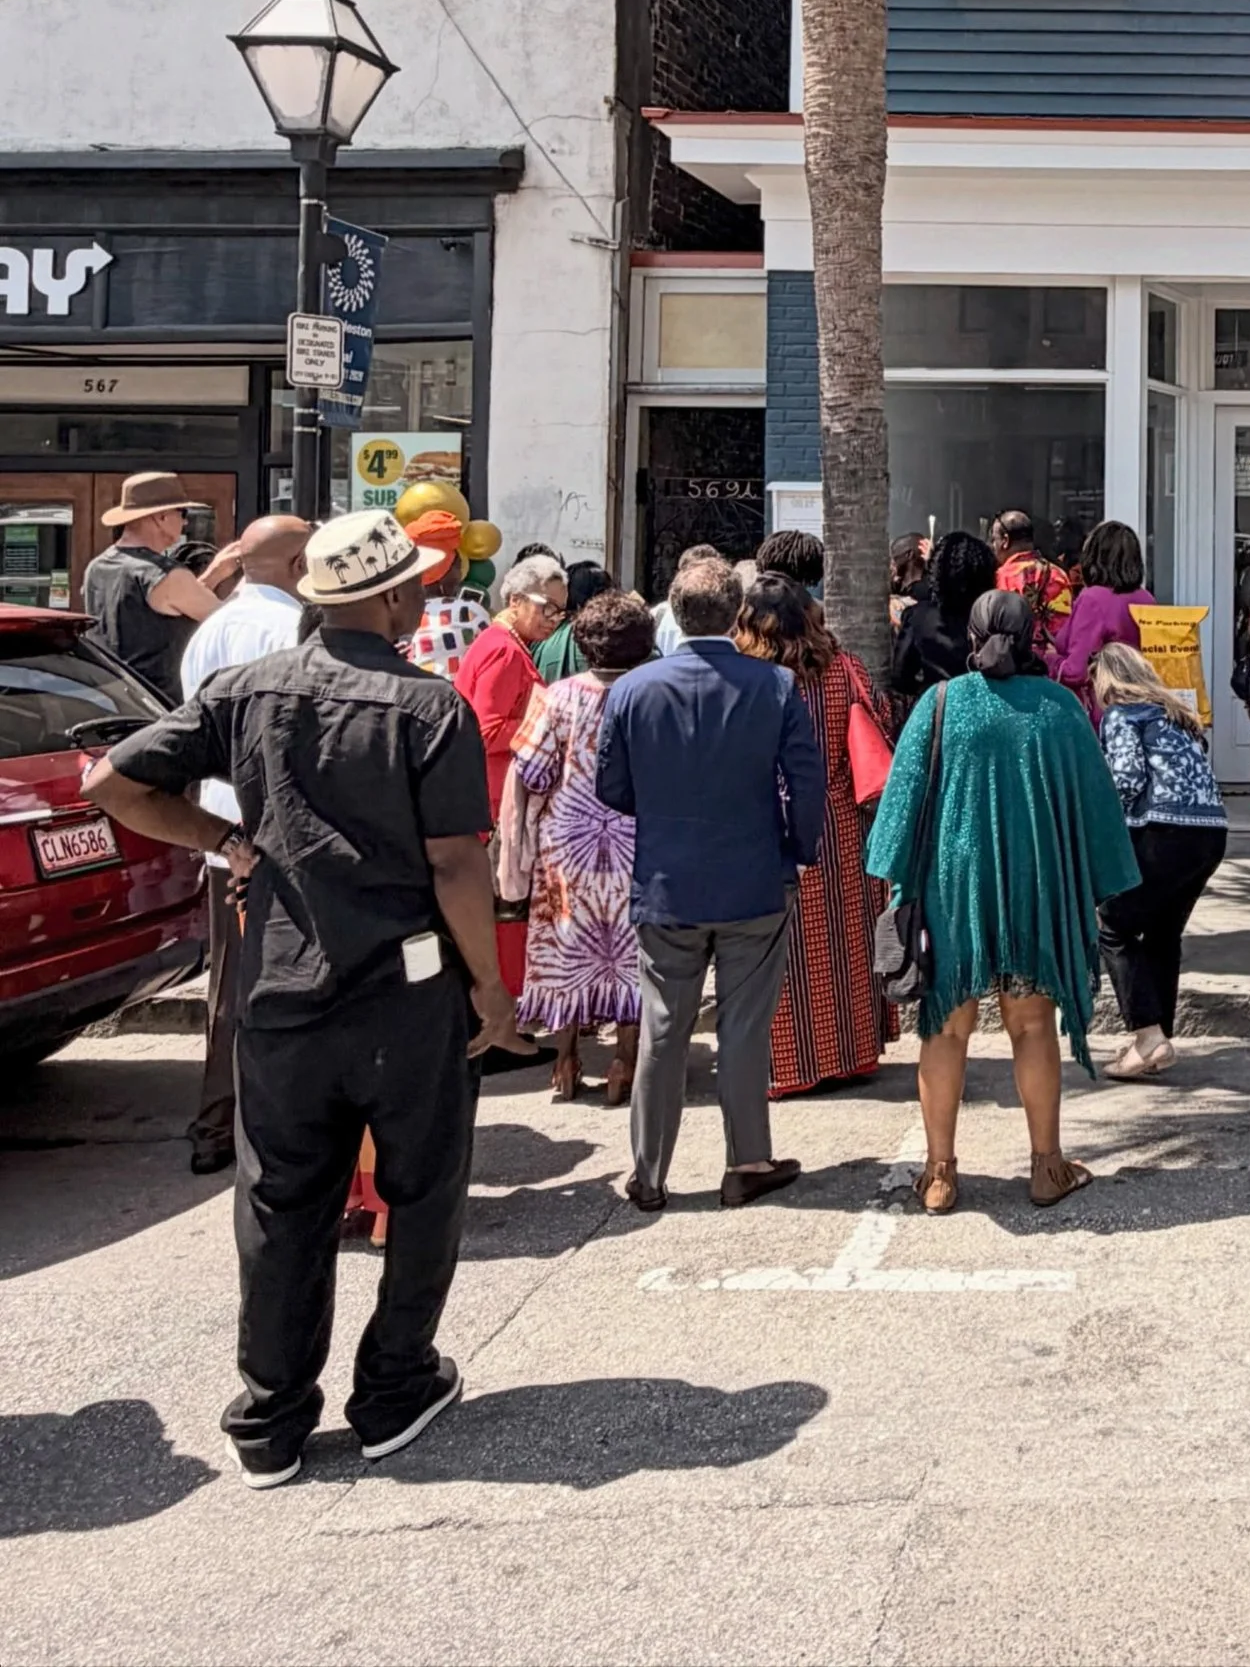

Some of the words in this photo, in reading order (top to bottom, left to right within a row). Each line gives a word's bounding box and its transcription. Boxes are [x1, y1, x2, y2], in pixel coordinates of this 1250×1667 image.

[84, 379, 119, 393] 567
[363, 490, 397, 506] SUB
[41, 828, 108, 862] CLN6586
